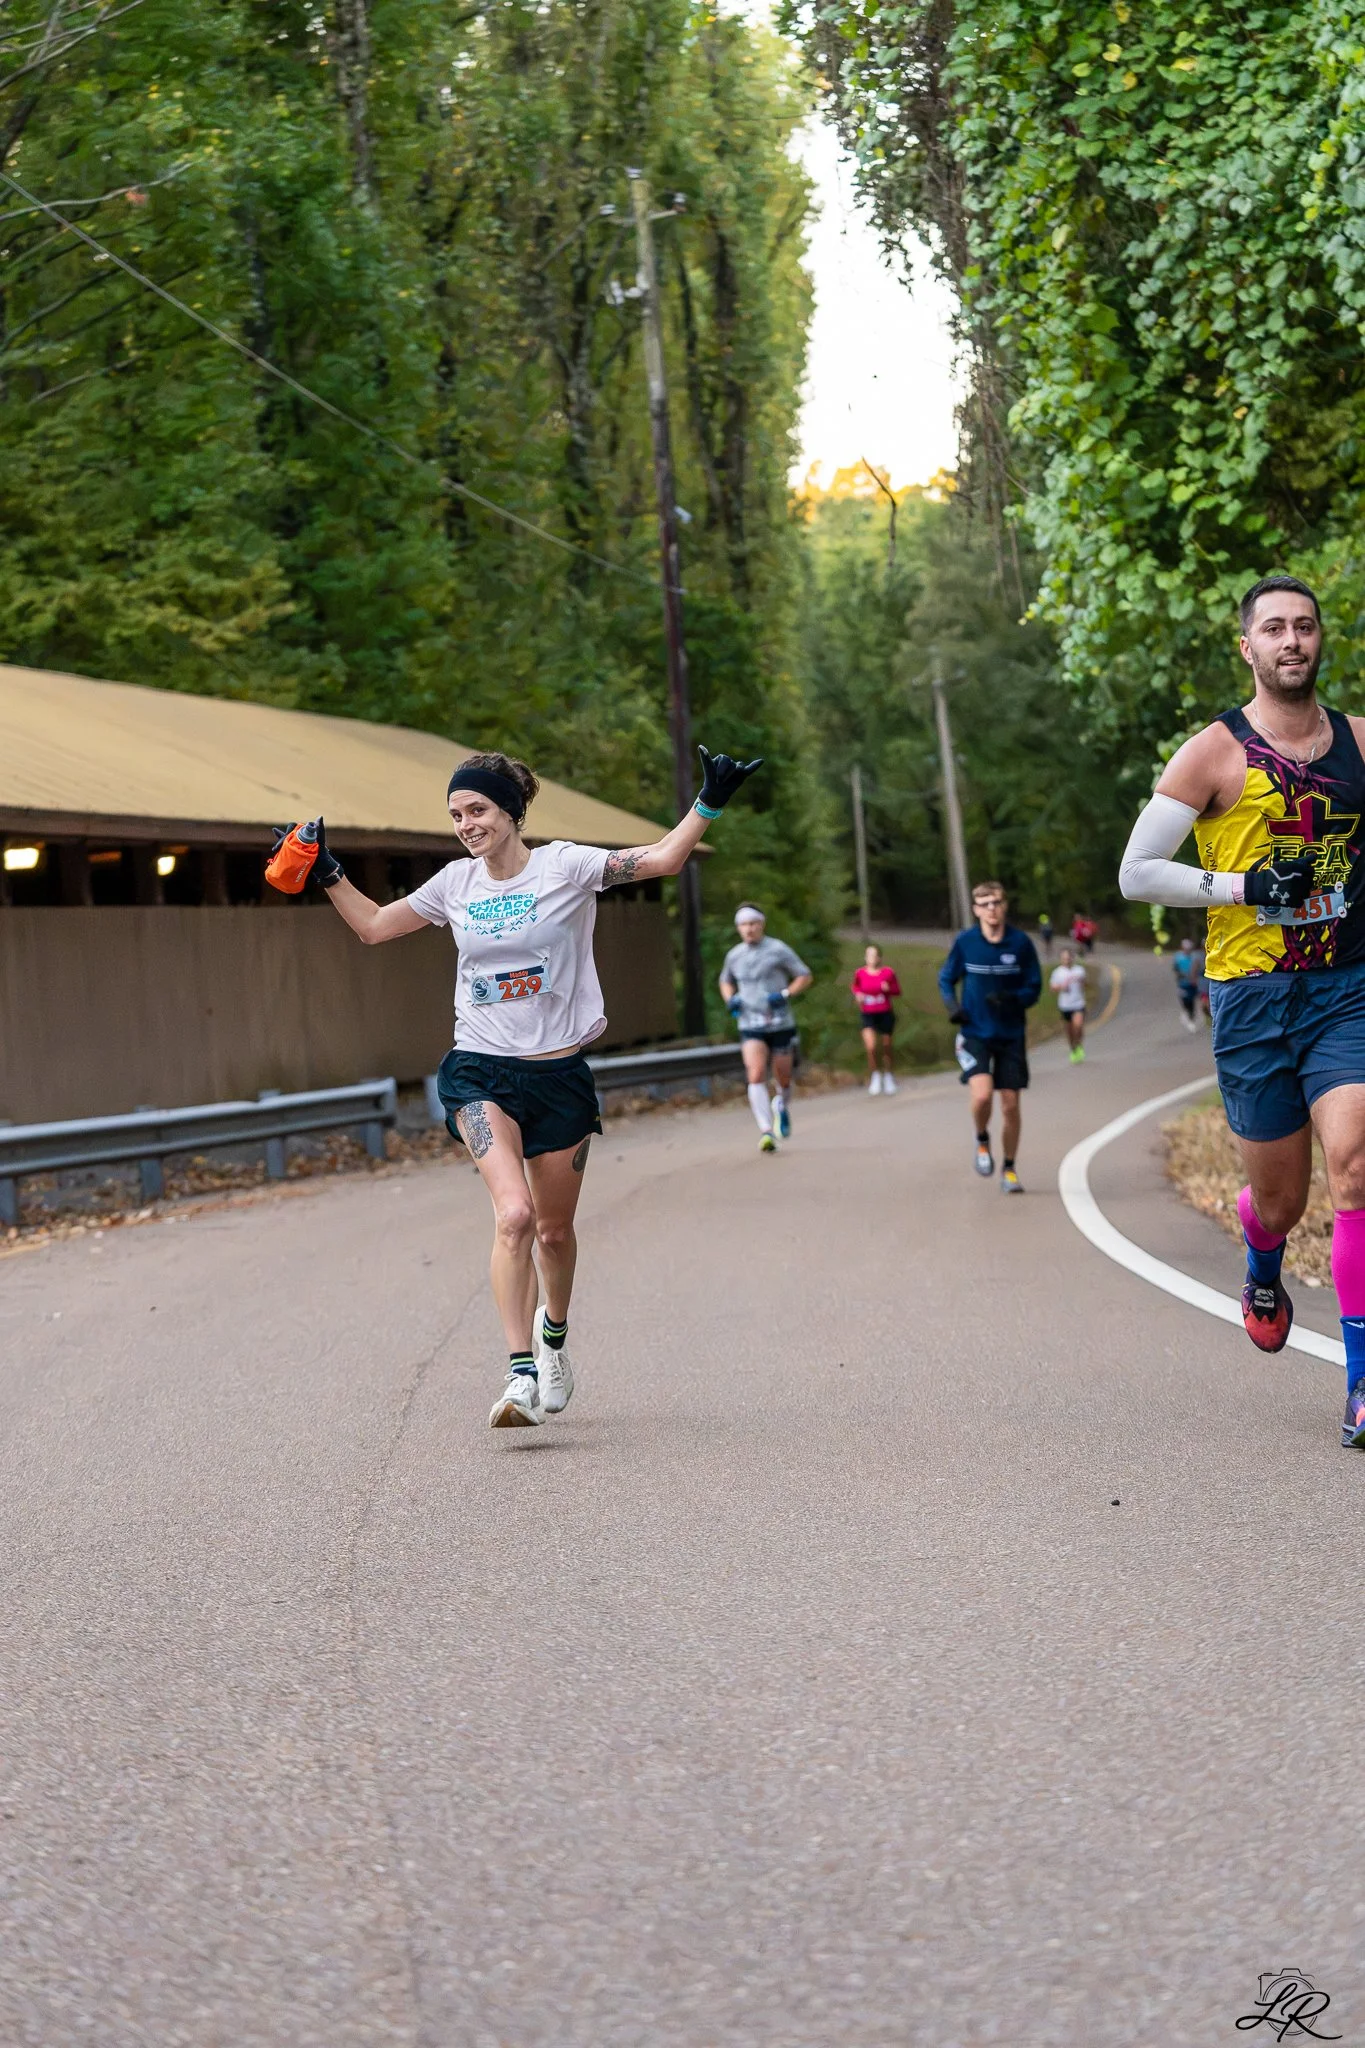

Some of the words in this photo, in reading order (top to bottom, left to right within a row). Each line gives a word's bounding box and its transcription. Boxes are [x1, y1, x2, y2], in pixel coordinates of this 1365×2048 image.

[468, 899, 533, 916] CHICAGO
[492, 896, 501, 904] OF
[1293, 895, 1333, 921] 451
[472, 908, 527, 920] MARATHON
[498, 975, 543, 1001] 229
